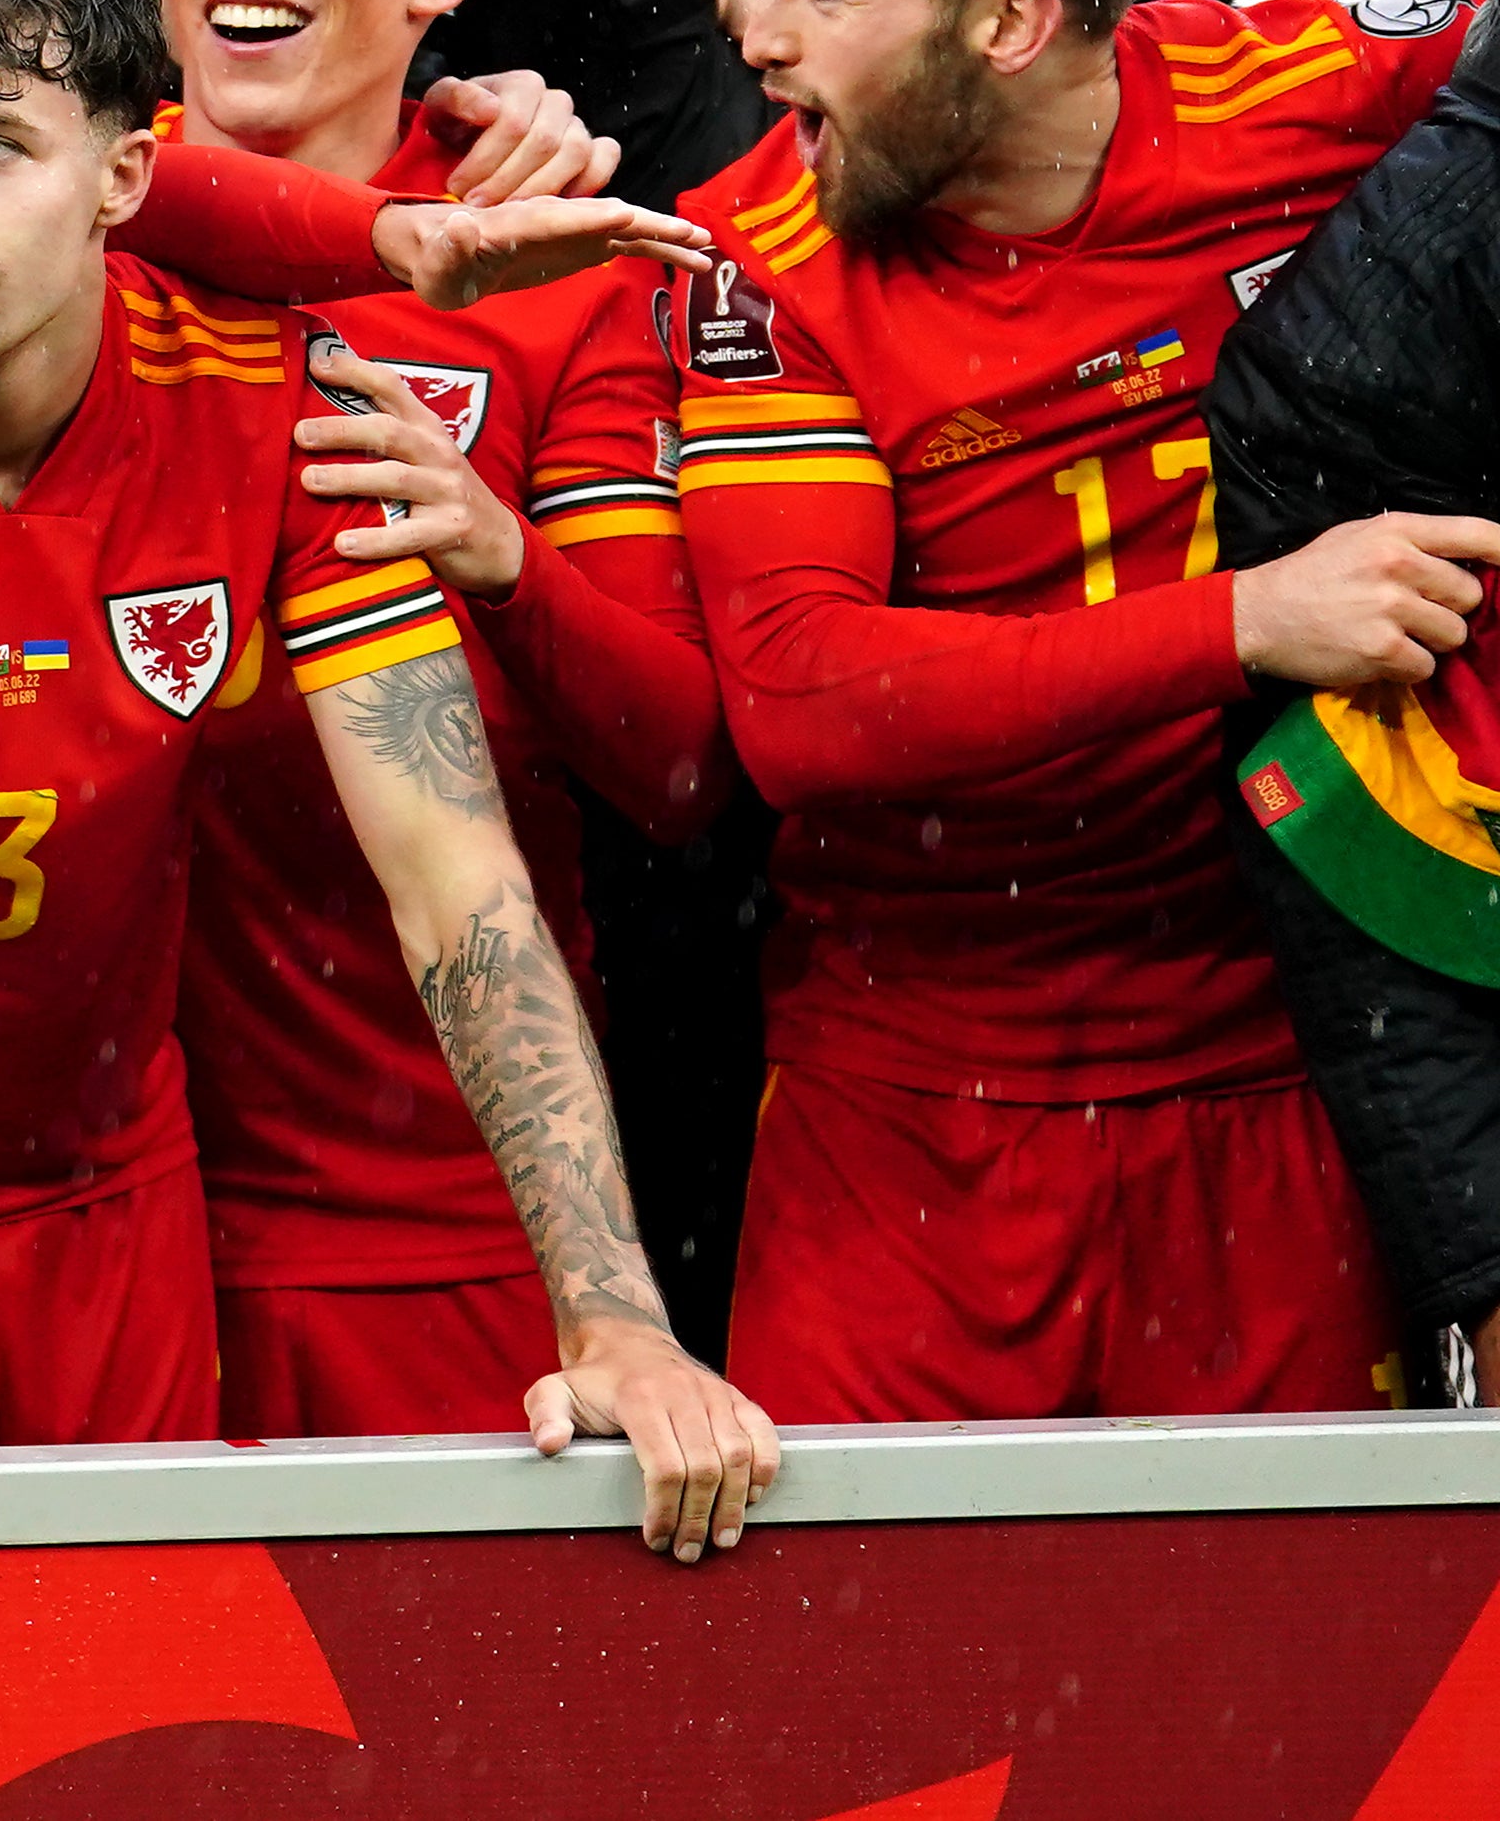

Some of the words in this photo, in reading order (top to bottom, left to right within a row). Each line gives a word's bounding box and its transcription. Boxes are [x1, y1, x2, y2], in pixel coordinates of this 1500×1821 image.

[1112, 367, 1163, 395] 05.06.22
[920, 427, 1023, 469] adidas
[1053, 437, 1219, 606] 17
